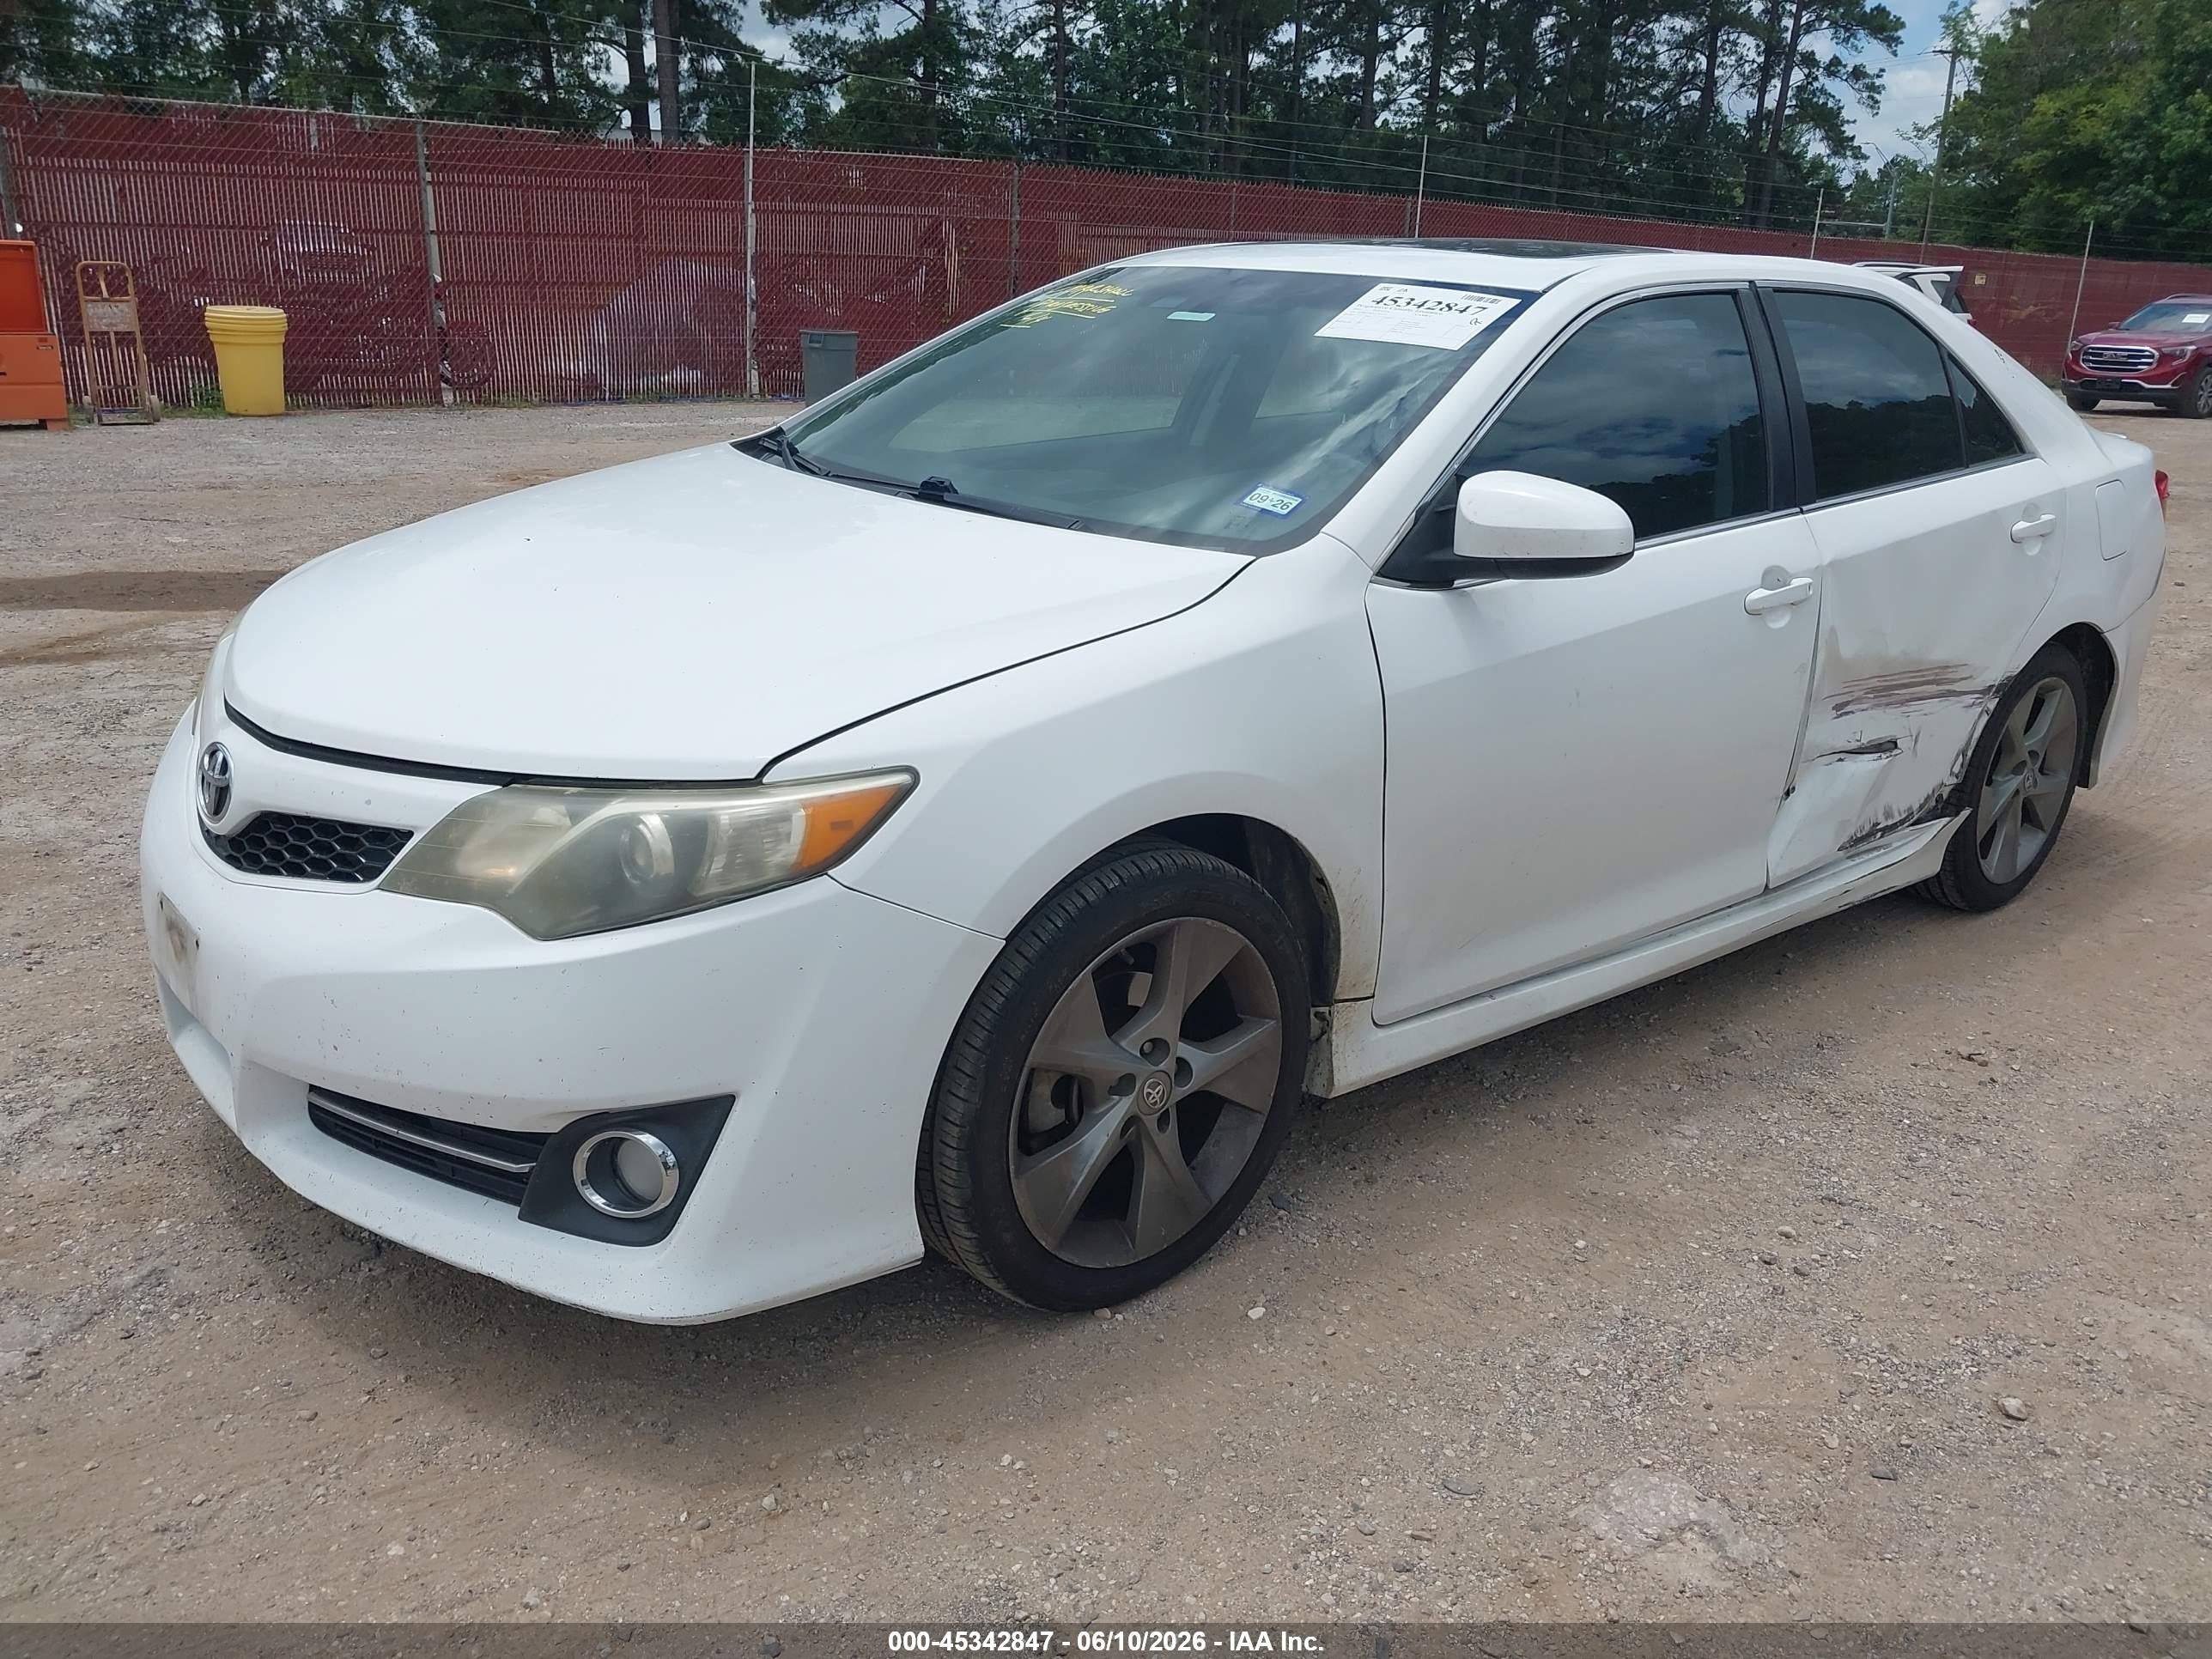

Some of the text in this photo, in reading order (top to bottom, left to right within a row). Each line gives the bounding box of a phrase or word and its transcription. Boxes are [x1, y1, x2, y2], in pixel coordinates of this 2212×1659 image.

[1371, 294, 1489, 315] 45342847
[1249, 492, 1269, 503] 09
[1271, 499, 1293, 510] 26
